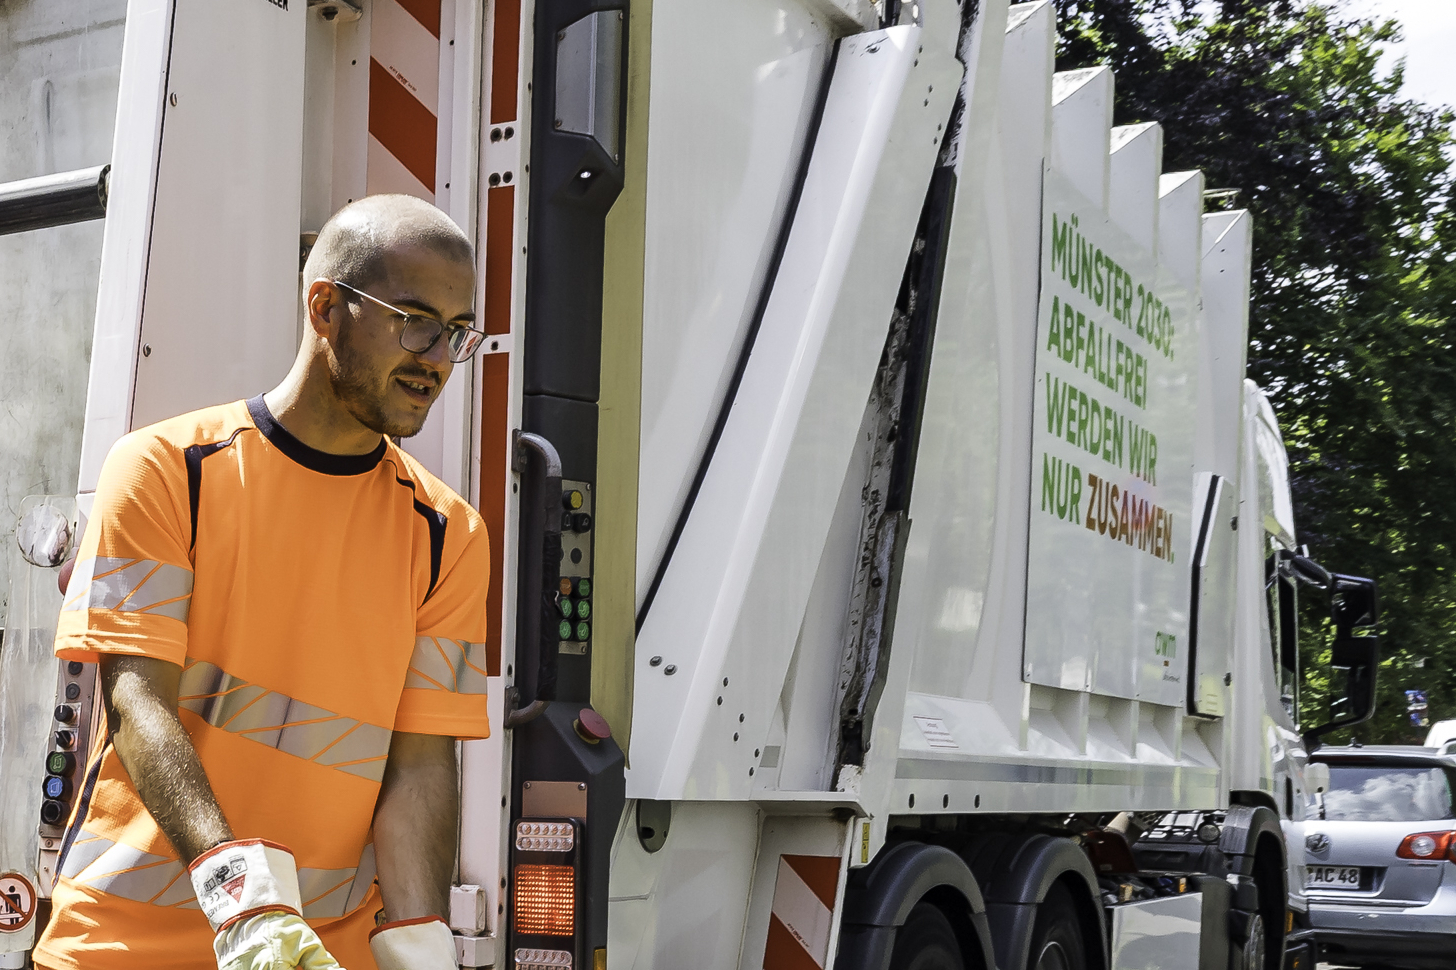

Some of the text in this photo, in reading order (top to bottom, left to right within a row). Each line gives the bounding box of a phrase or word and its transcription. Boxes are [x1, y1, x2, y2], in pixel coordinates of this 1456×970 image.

[1051, 212, 1174, 361] MÜNSTER 2030:
[1046, 295, 1147, 410] ABFALLFREI
[1046, 372, 1158, 487] WERDEN WIR
[1042, 452, 1174, 564] NUR ZUSAMMEN.
